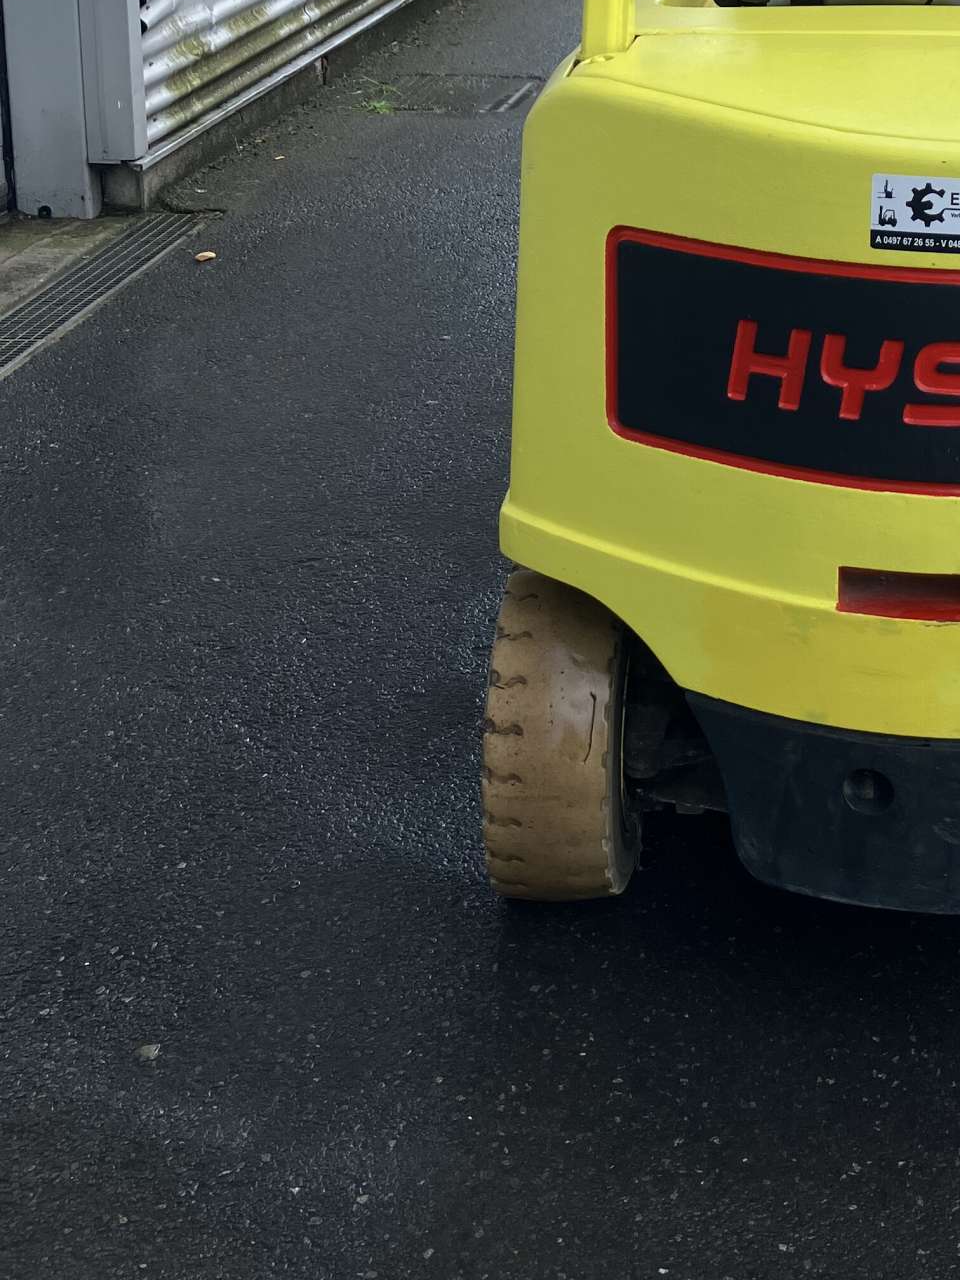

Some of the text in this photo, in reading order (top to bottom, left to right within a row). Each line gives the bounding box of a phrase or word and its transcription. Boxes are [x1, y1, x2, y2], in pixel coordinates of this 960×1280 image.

[875, 235, 881, 244] A
[883, 236, 901, 245] 0497
[903, 237, 912, 245] 67
[914, 237, 923, 246] 26
[925, 238, 934, 247] 55
[941, 239, 947, 247] V
